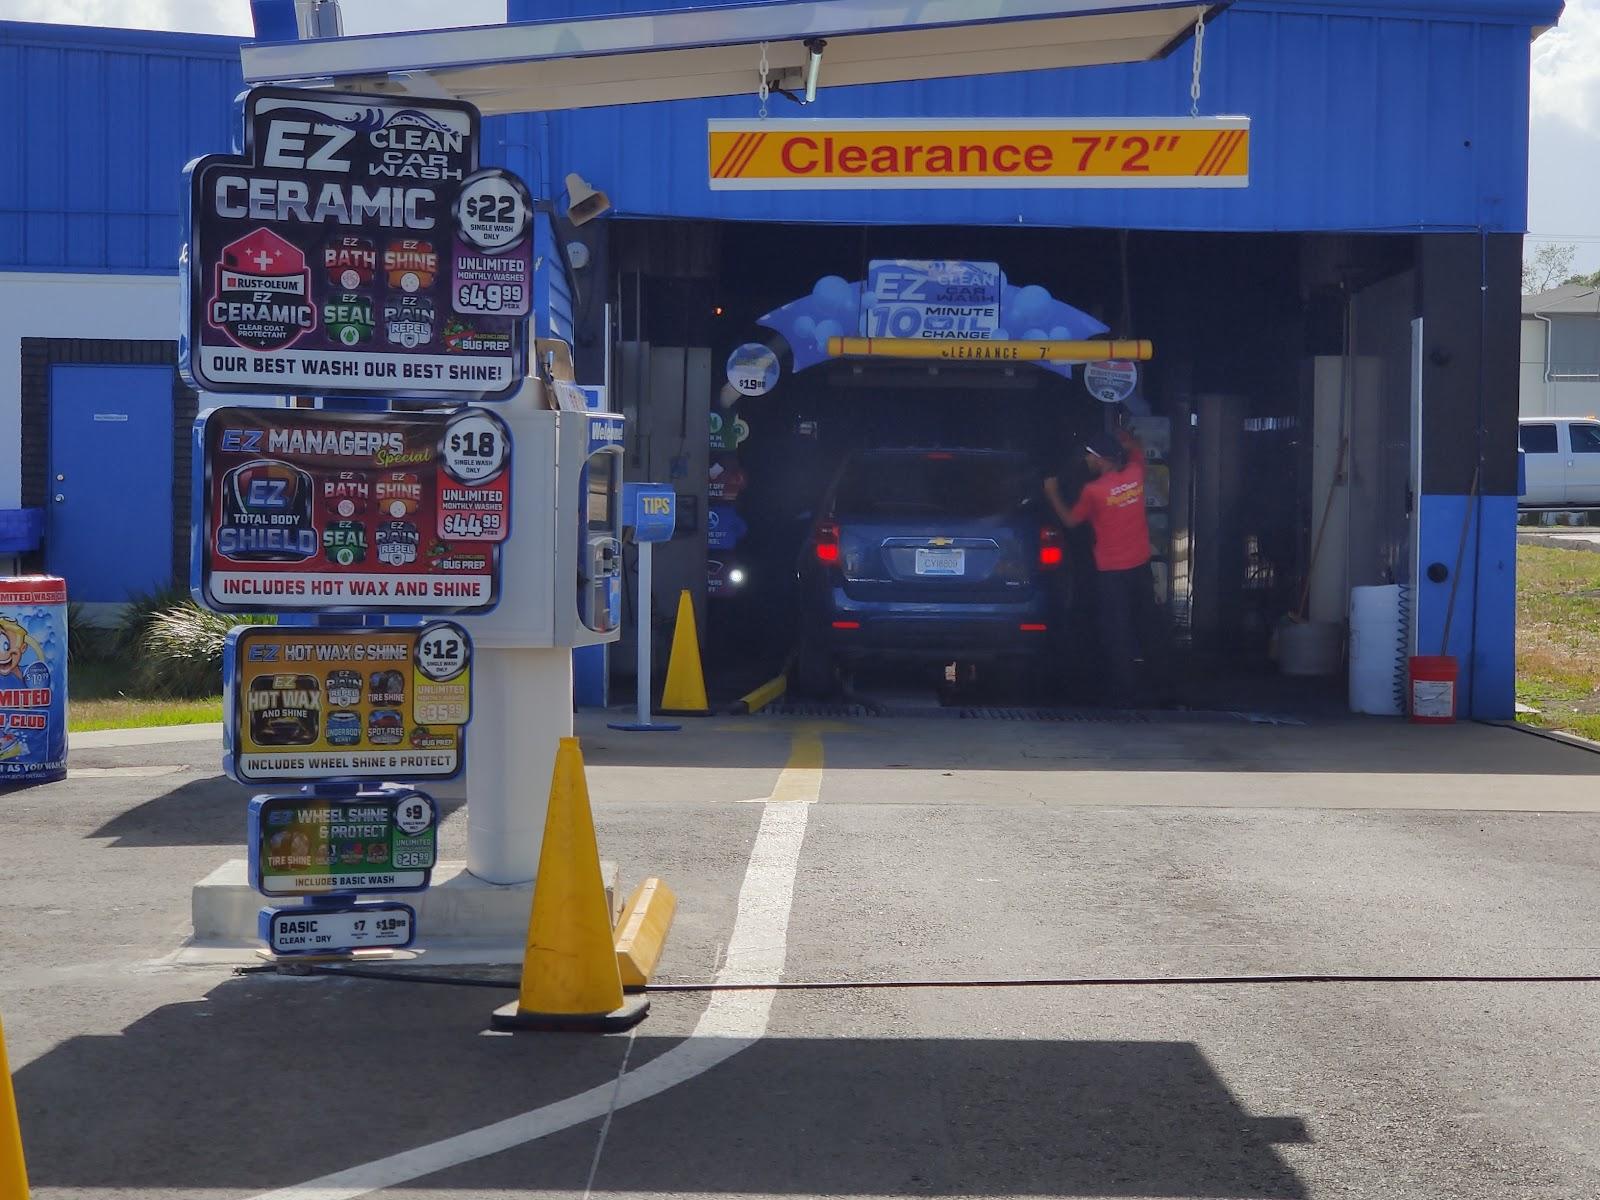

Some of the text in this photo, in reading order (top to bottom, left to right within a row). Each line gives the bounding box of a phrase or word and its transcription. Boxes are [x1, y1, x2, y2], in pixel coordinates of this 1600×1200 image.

[263, 119, 356, 172] EZ
[369, 129, 463, 153] CLEAN
[383, 151, 448, 167] CAR
[781, 136, 1054, 175] Clearance
[368, 163, 462, 181] WASH
[215, 175, 436, 230] CERAMIC
[467, 195, 515, 223] $22
[470, 224, 513, 232] SINGLE WASH
[343, 238, 359, 246] EZ
[403, 240, 418, 250] EZ
[324, 249, 376, 270] BATH
[384, 251, 437, 272] SHINE
[458, 257, 525, 272] UNLIMITED
[458, 272, 525, 282] MONTHLY WASHES
[937, 275, 995, 287] CLEAN
[238, 278, 298, 291] RUST-OLEUM
[875, 272, 928, 301] EZ
[945, 287, 986, 295] CAR
[253, 292, 272, 303] EZ
[342, 294, 358, 303] EZ
[402, 297, 418, 305] EZ
[213, 302, 311, 327] CERAMIC
[324, 305, 376, 326] SEAL
[384, 308, 435, 321] RAIN
[925, 307, 995, 317] MINUTE
[238, 323, 284, 332] CLEAR COAT
[872, 306, 922, 338] 10
[923, 316, 991, 331] OIL
[238, 331, 287, 339] PROTECTANT
[391, 323, 428, 335] REPEL
[922, 330, 992, 339] CHANGE
[462, 340, 510, 351] BUG PREP
[213, 356, 502, 381] OUR BEST WASH! OUR BEST SHINE!
[221, 429, 404, 456] EZ MANAGER'S
[451, 432, 495, 457] $18
[375, 448, 432, 467] Special
[340, 471, 354, 480] EZ
[392, 473, 406, 481] EZ
[250, 480, 287, 505] EZ
[324, 482, 369, 499] BATH
[375, 483, 422, 500] SHINE
[442, 490, 503, 502] UNLIMITED
[442, 502, 503, 511] MONTHLY WASHES
[643, 496, 670, 515] TIPS
[233, 513, 300, 525] TOTAL BODY
[339, 520, 352, 528] EZ
[390, 521, 404, 529] EZ
[220, 527, 317, 553] SHIELD
[323, 531, 368, 548] SEAL
[381, 545, 413, 554] REPEL
[443, 560, 486, 570] BUG PREP
[223, 579, 481, 597] INCLUDES HOT WAX AND SHINE
[0, 593, 31, 601] MITED
[248, 644, 281, 662] EZ
[284, 644, 313, 661] HOT
[315, 644, 350, 661] WAX
[367, 644, 408, 660] SHINE
[424, 640, 458, 659] $12
[274, 676, 296, 687] EZ
[418, 685, 465, 694] UNLIMITED
[0, 689, 50, 707] MITED
[248, 690, 321, 710] HOT WAX
[368, 693, 405, 703] TIRE SHINE
[262, 709, 308, 718] AND SHINE
[10, 715, 45, 728] CLUB
[325, 728, 361, 737] UNDERBODY
[368, 727, 404, 737] SPOT FREE
[7, 764, 21, 772] AS
[23, 763, 43, 772] YOU
[248, 755, 451, 770] INCLUDES WHEEL SHINE & PROTECT
[297, 809, 346, 824] WHEEL
[348, 808, 388, 822] SHINE
[406, 804, 422, 819] $9
[331, 825, 387, 838] PROTECT
[268, 856, 286, 867] TIRE
[287, 855, 312, 866] SHINE
[295, 875, 395, 886] INCLUDES BASIC WASH
[279, 920, 319, 934] BASIC
[354, 920, 366, 931] $7
[279, 936, 306, 945] CLEAN
[315, 935, 332, 943] DRY
